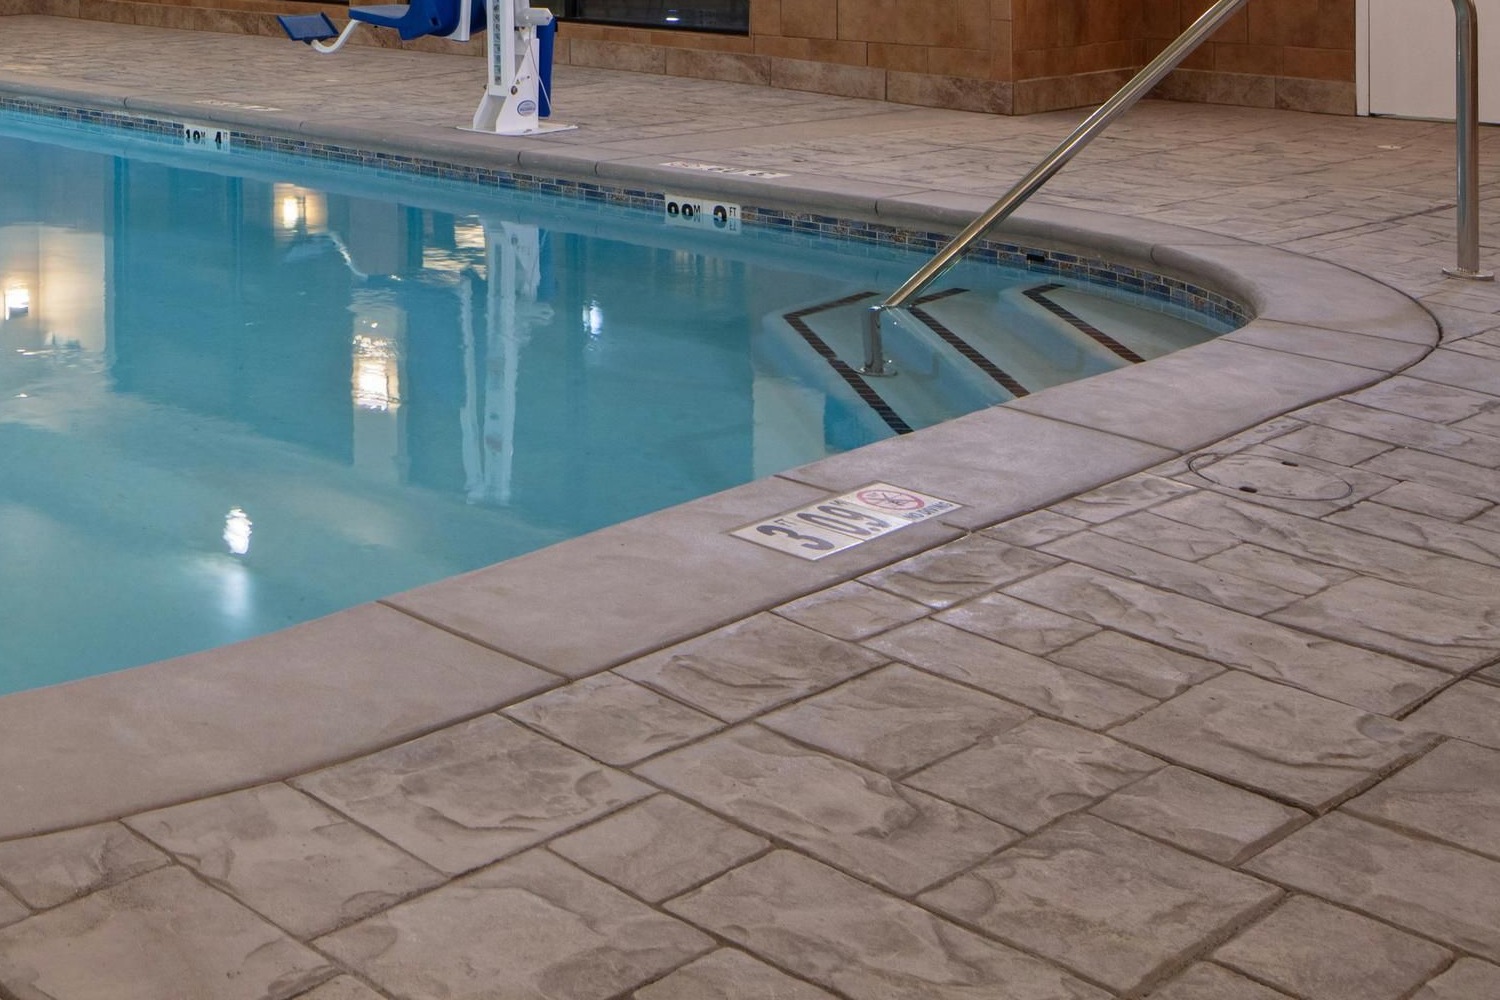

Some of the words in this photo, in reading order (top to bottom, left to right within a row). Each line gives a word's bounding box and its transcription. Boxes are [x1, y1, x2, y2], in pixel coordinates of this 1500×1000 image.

[918, 501, 954, 514] DIVING
[756, 525, 835, 550] 3
[797, 505, 891, 535] 0.9
